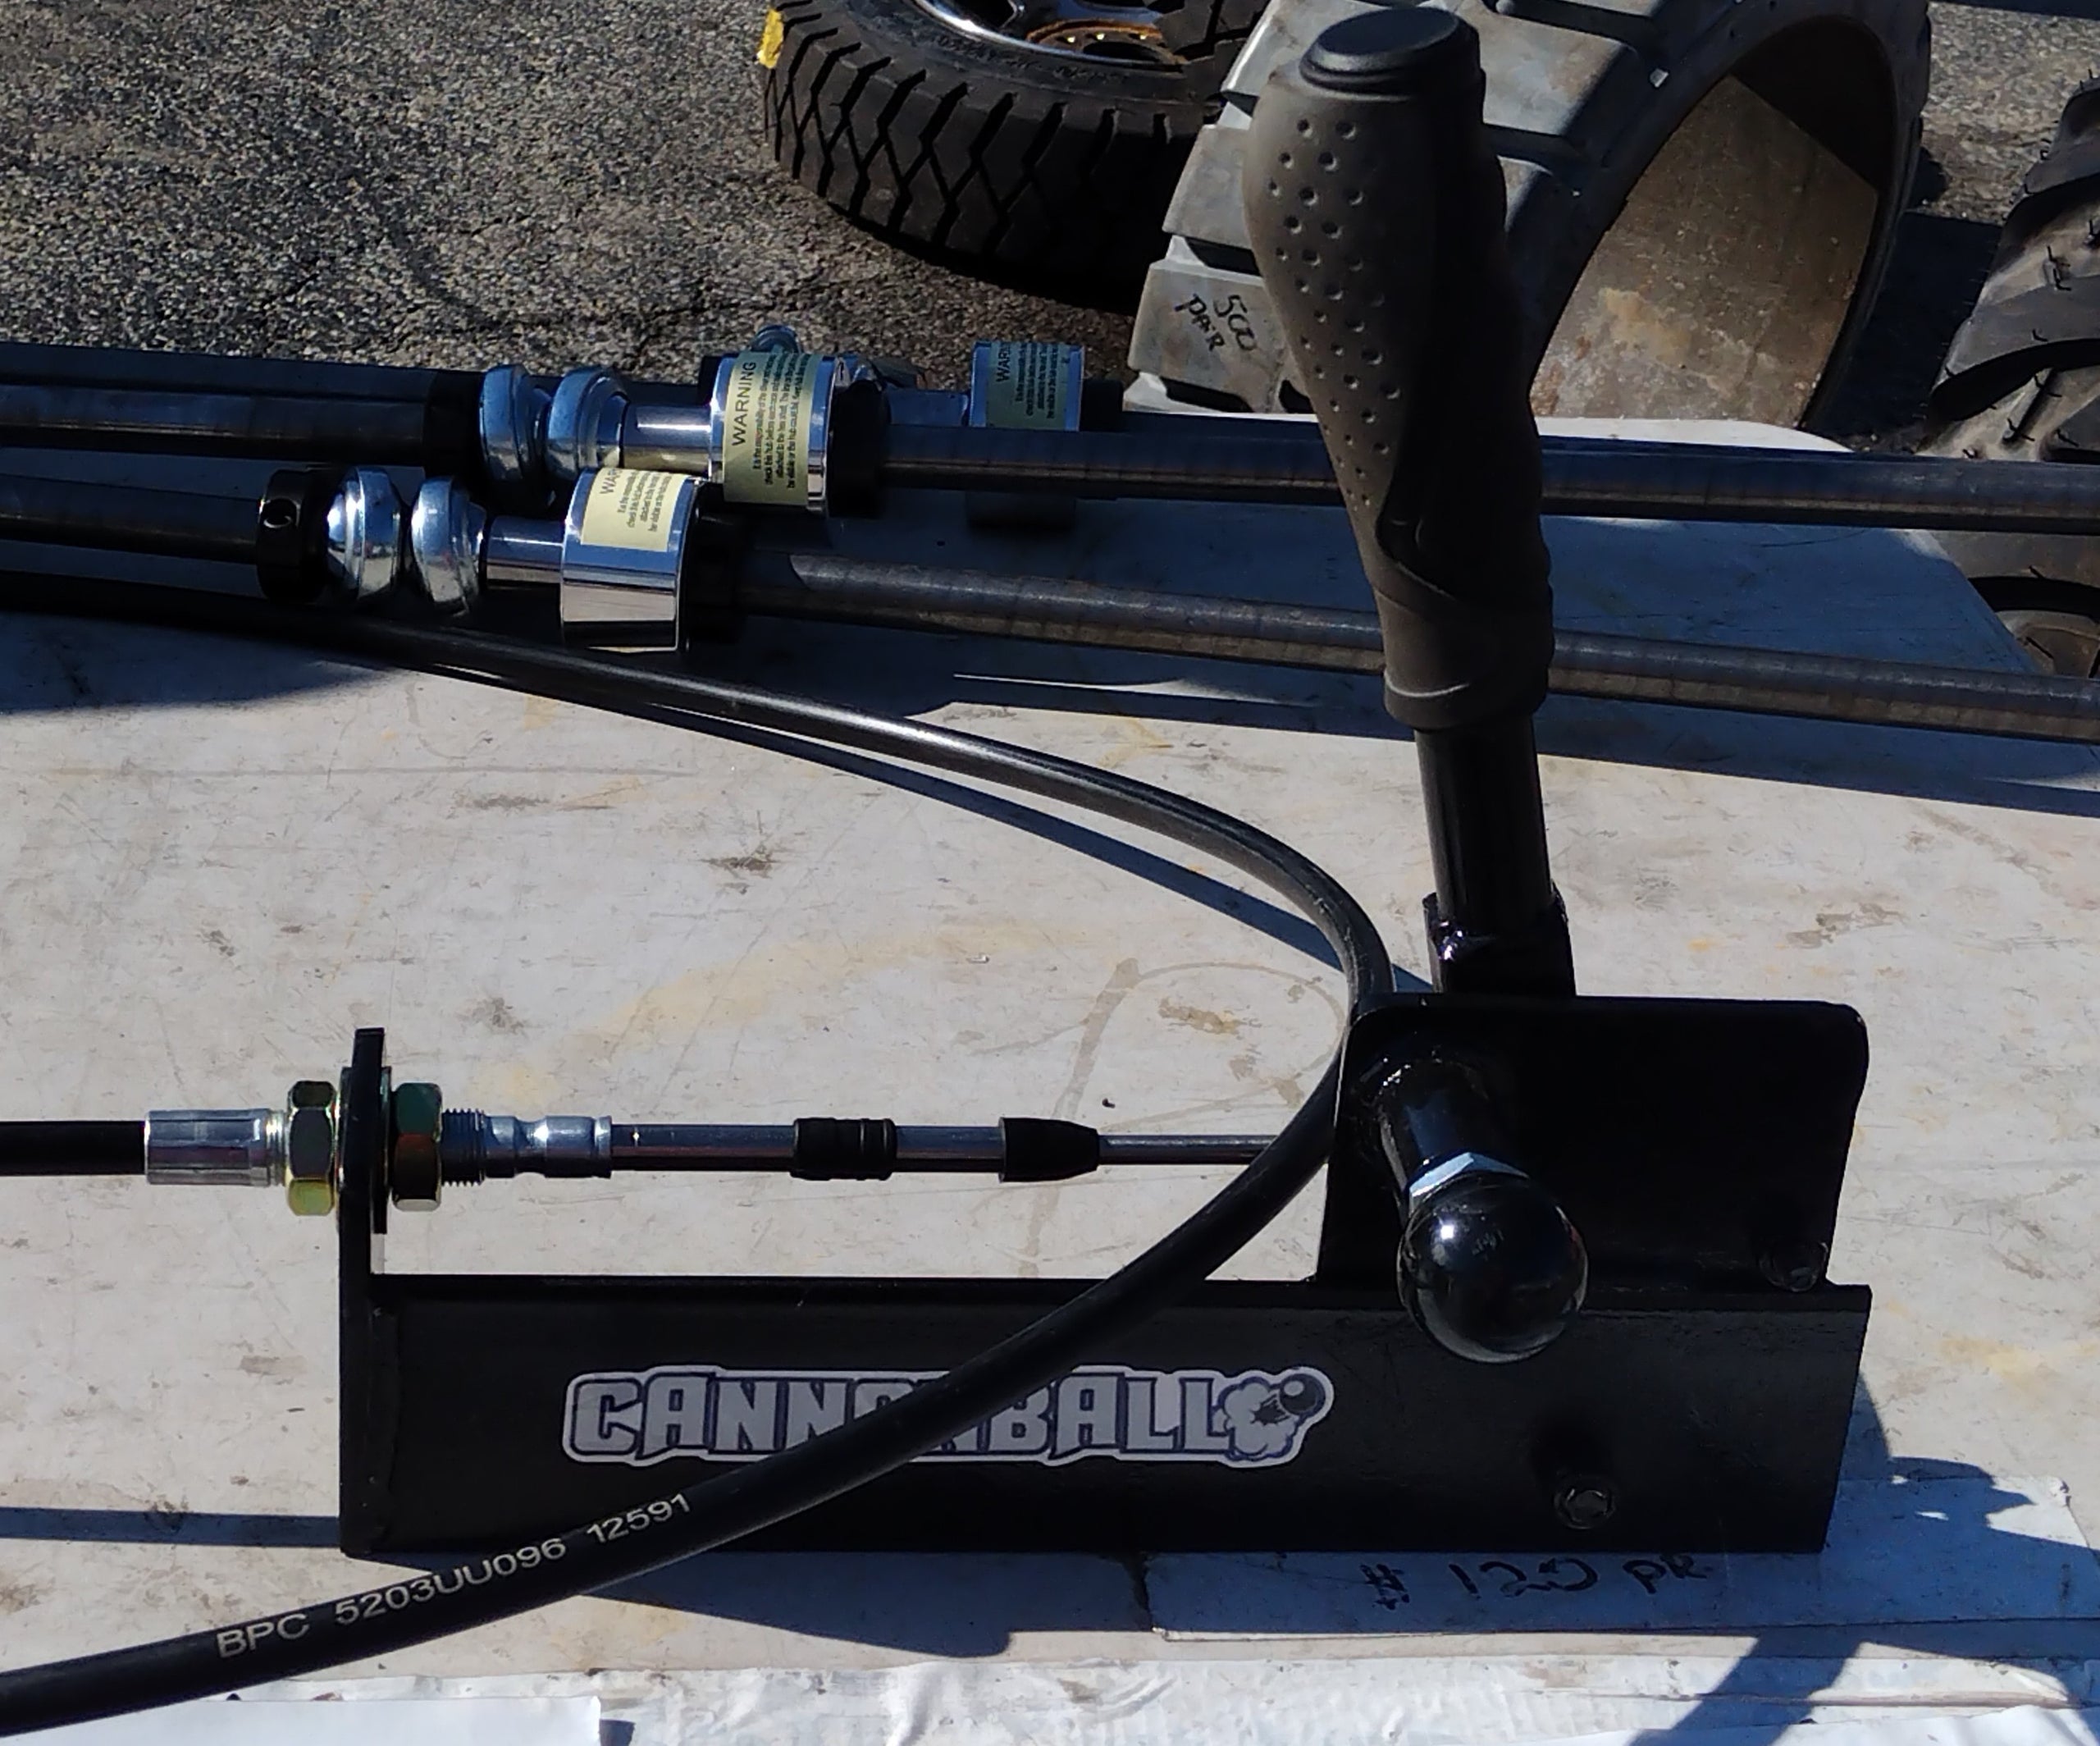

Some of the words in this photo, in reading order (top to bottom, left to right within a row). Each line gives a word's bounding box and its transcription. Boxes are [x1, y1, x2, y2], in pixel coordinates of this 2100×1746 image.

[732, 361, 757, 446] WARNING
[568, 1370, 1238, 1461] CANNBALL
[216, 1611, 311, 1659] BPC
[334, 1537, 568, 1625] 5203UU096
[586, 1492, 692, 1545] 12591
